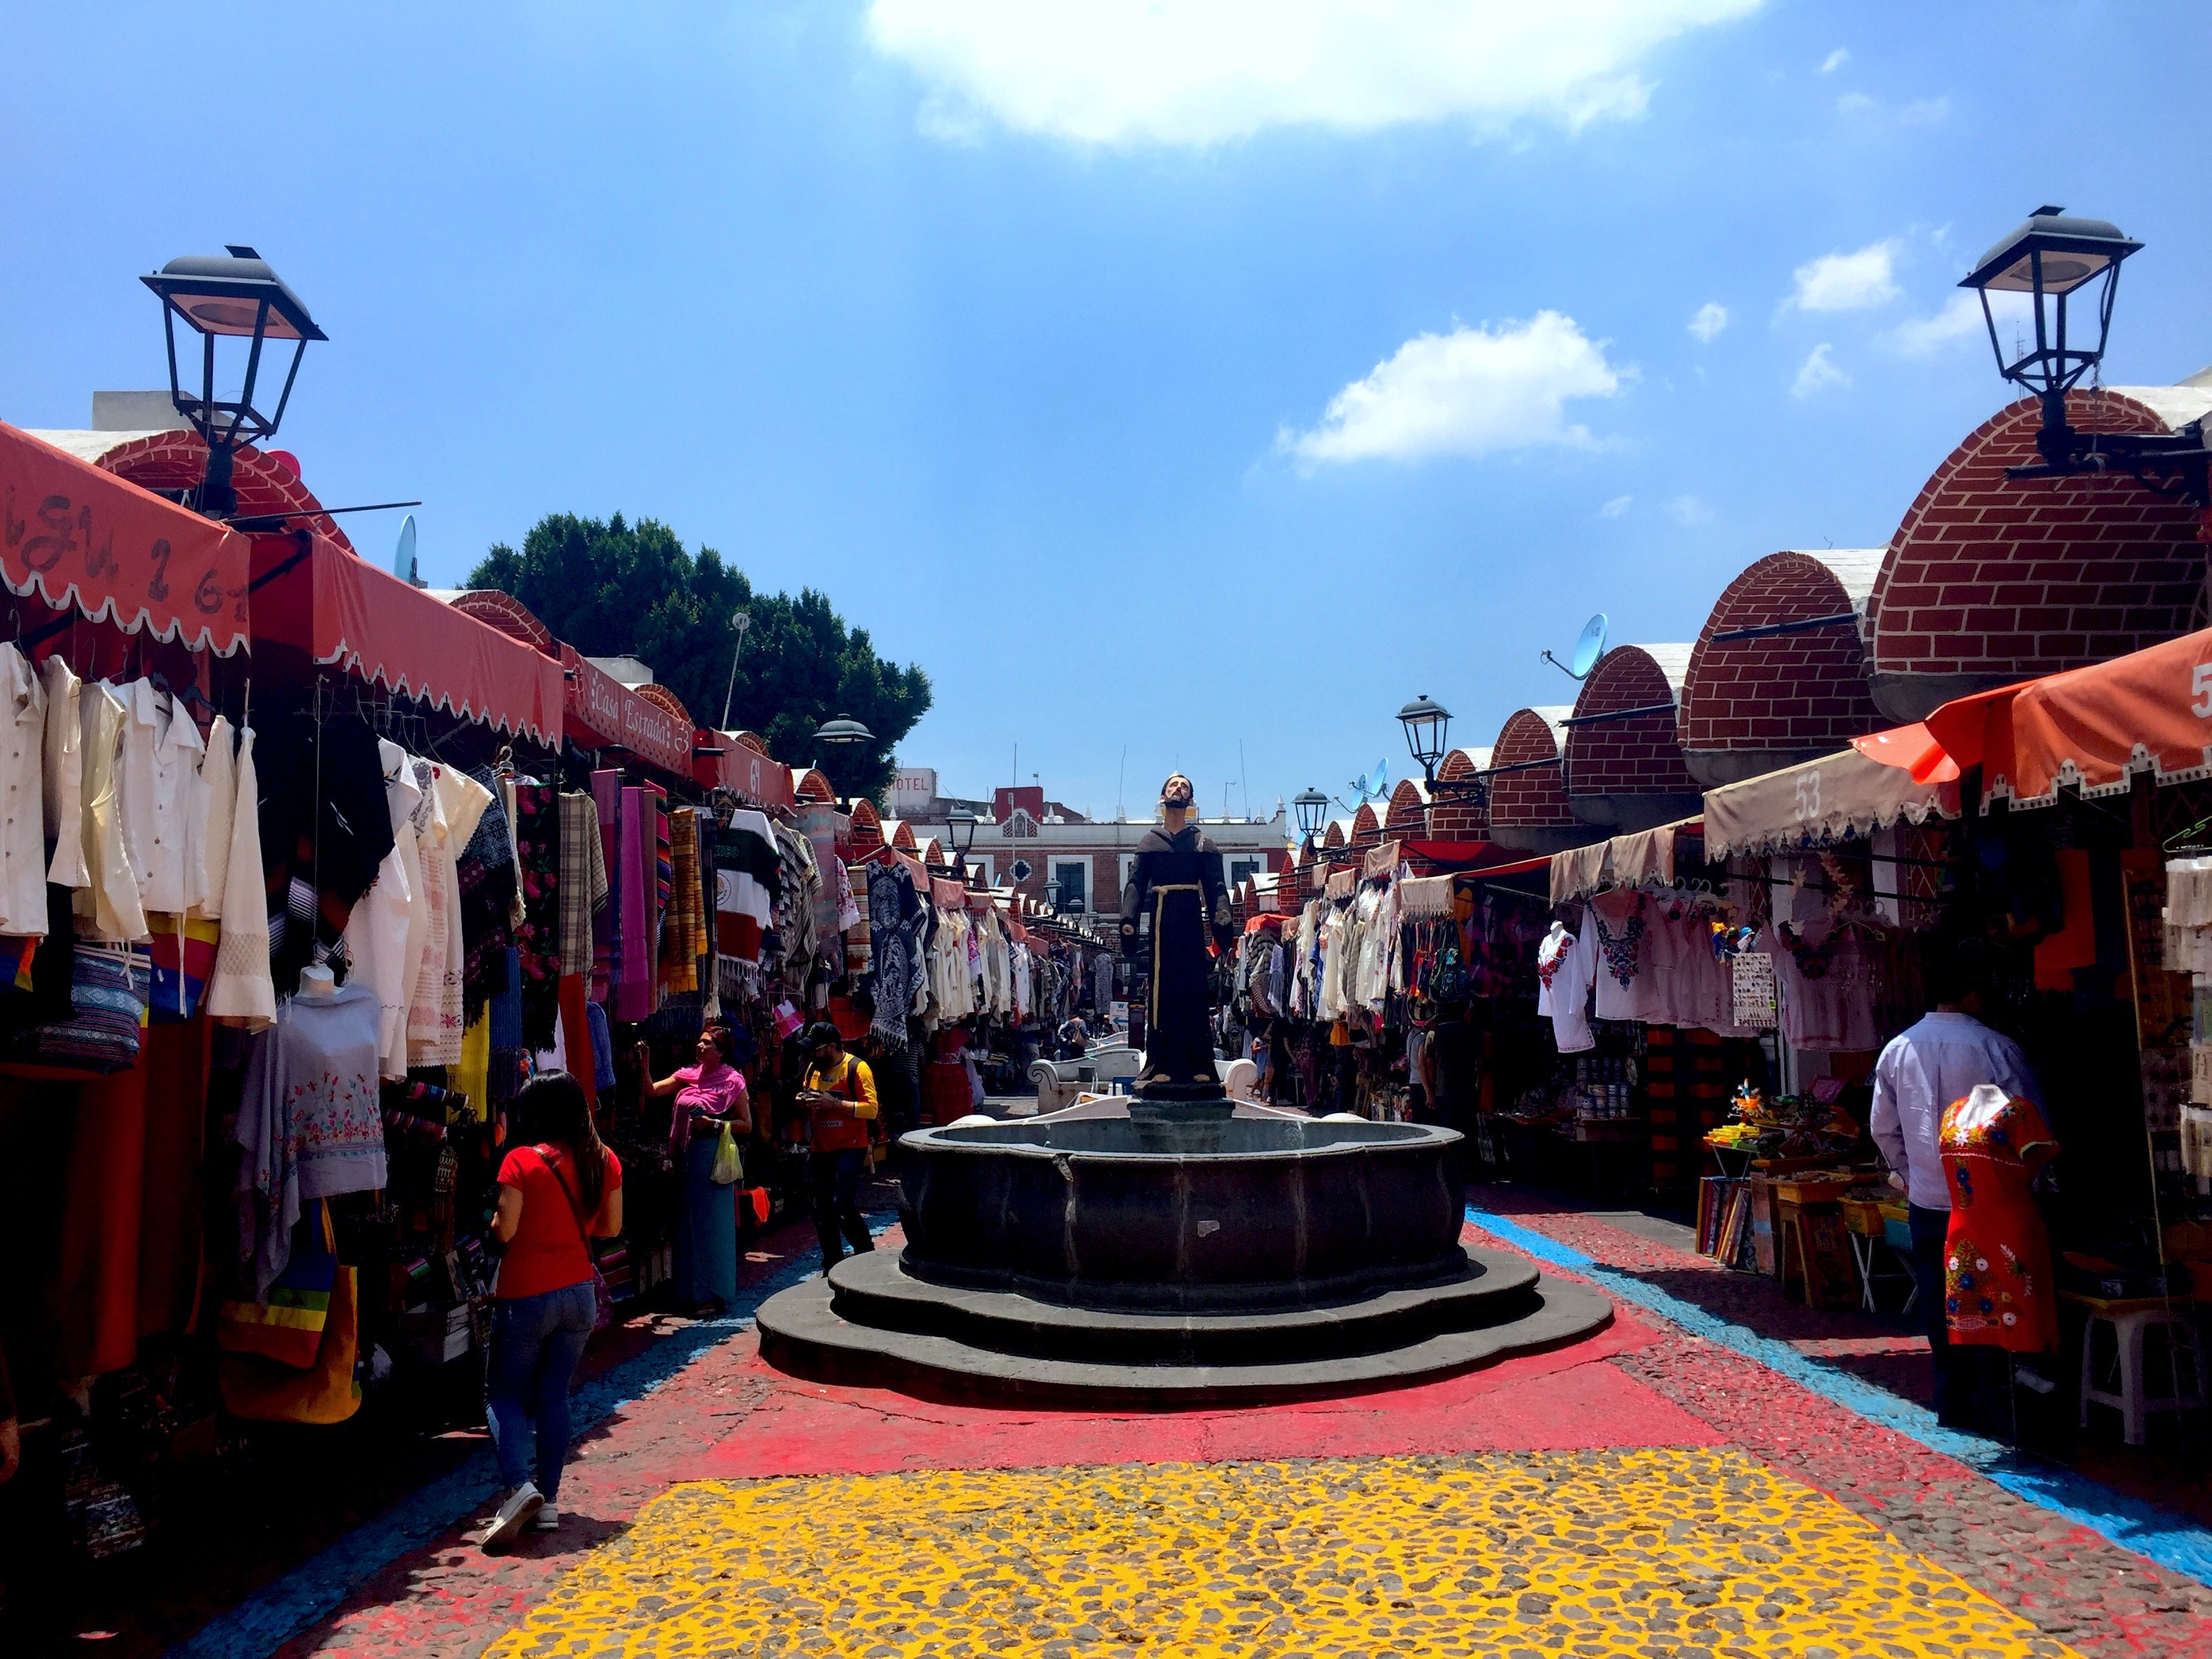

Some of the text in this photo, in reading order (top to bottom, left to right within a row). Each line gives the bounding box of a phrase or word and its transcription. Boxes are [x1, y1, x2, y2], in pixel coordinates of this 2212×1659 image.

[595, 683, 619, 720] Casa
[624, 699, 667, 745] Estrada
[750, 758, 760, 796] 64
[1795, 770, 1821, 821] 53
